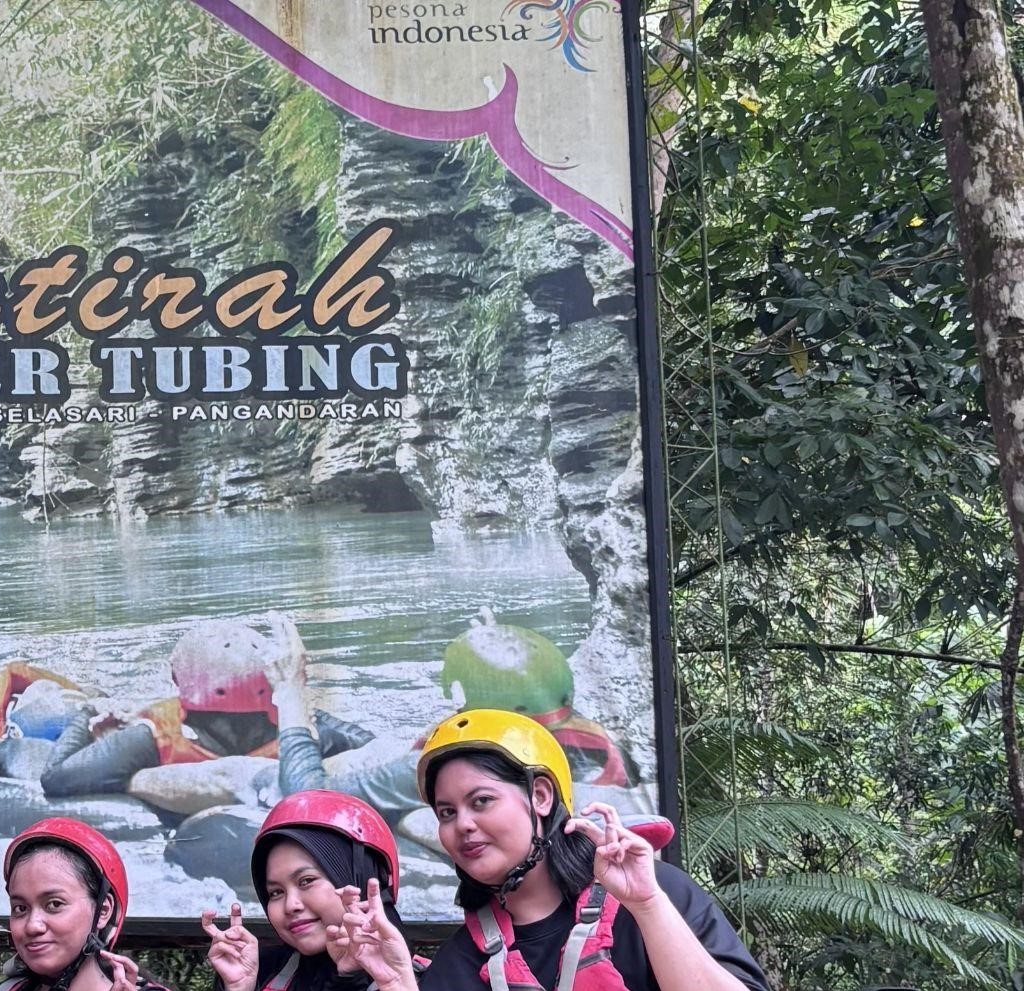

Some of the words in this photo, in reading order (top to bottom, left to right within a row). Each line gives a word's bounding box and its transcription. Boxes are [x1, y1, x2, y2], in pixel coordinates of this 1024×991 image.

[368, 1, 468, 23] pesona
[369, 20, 532, 44] indonesia
[100, 342, 401, 395] TUBING
[171, 402, 403, 420] PANGANDARAN
